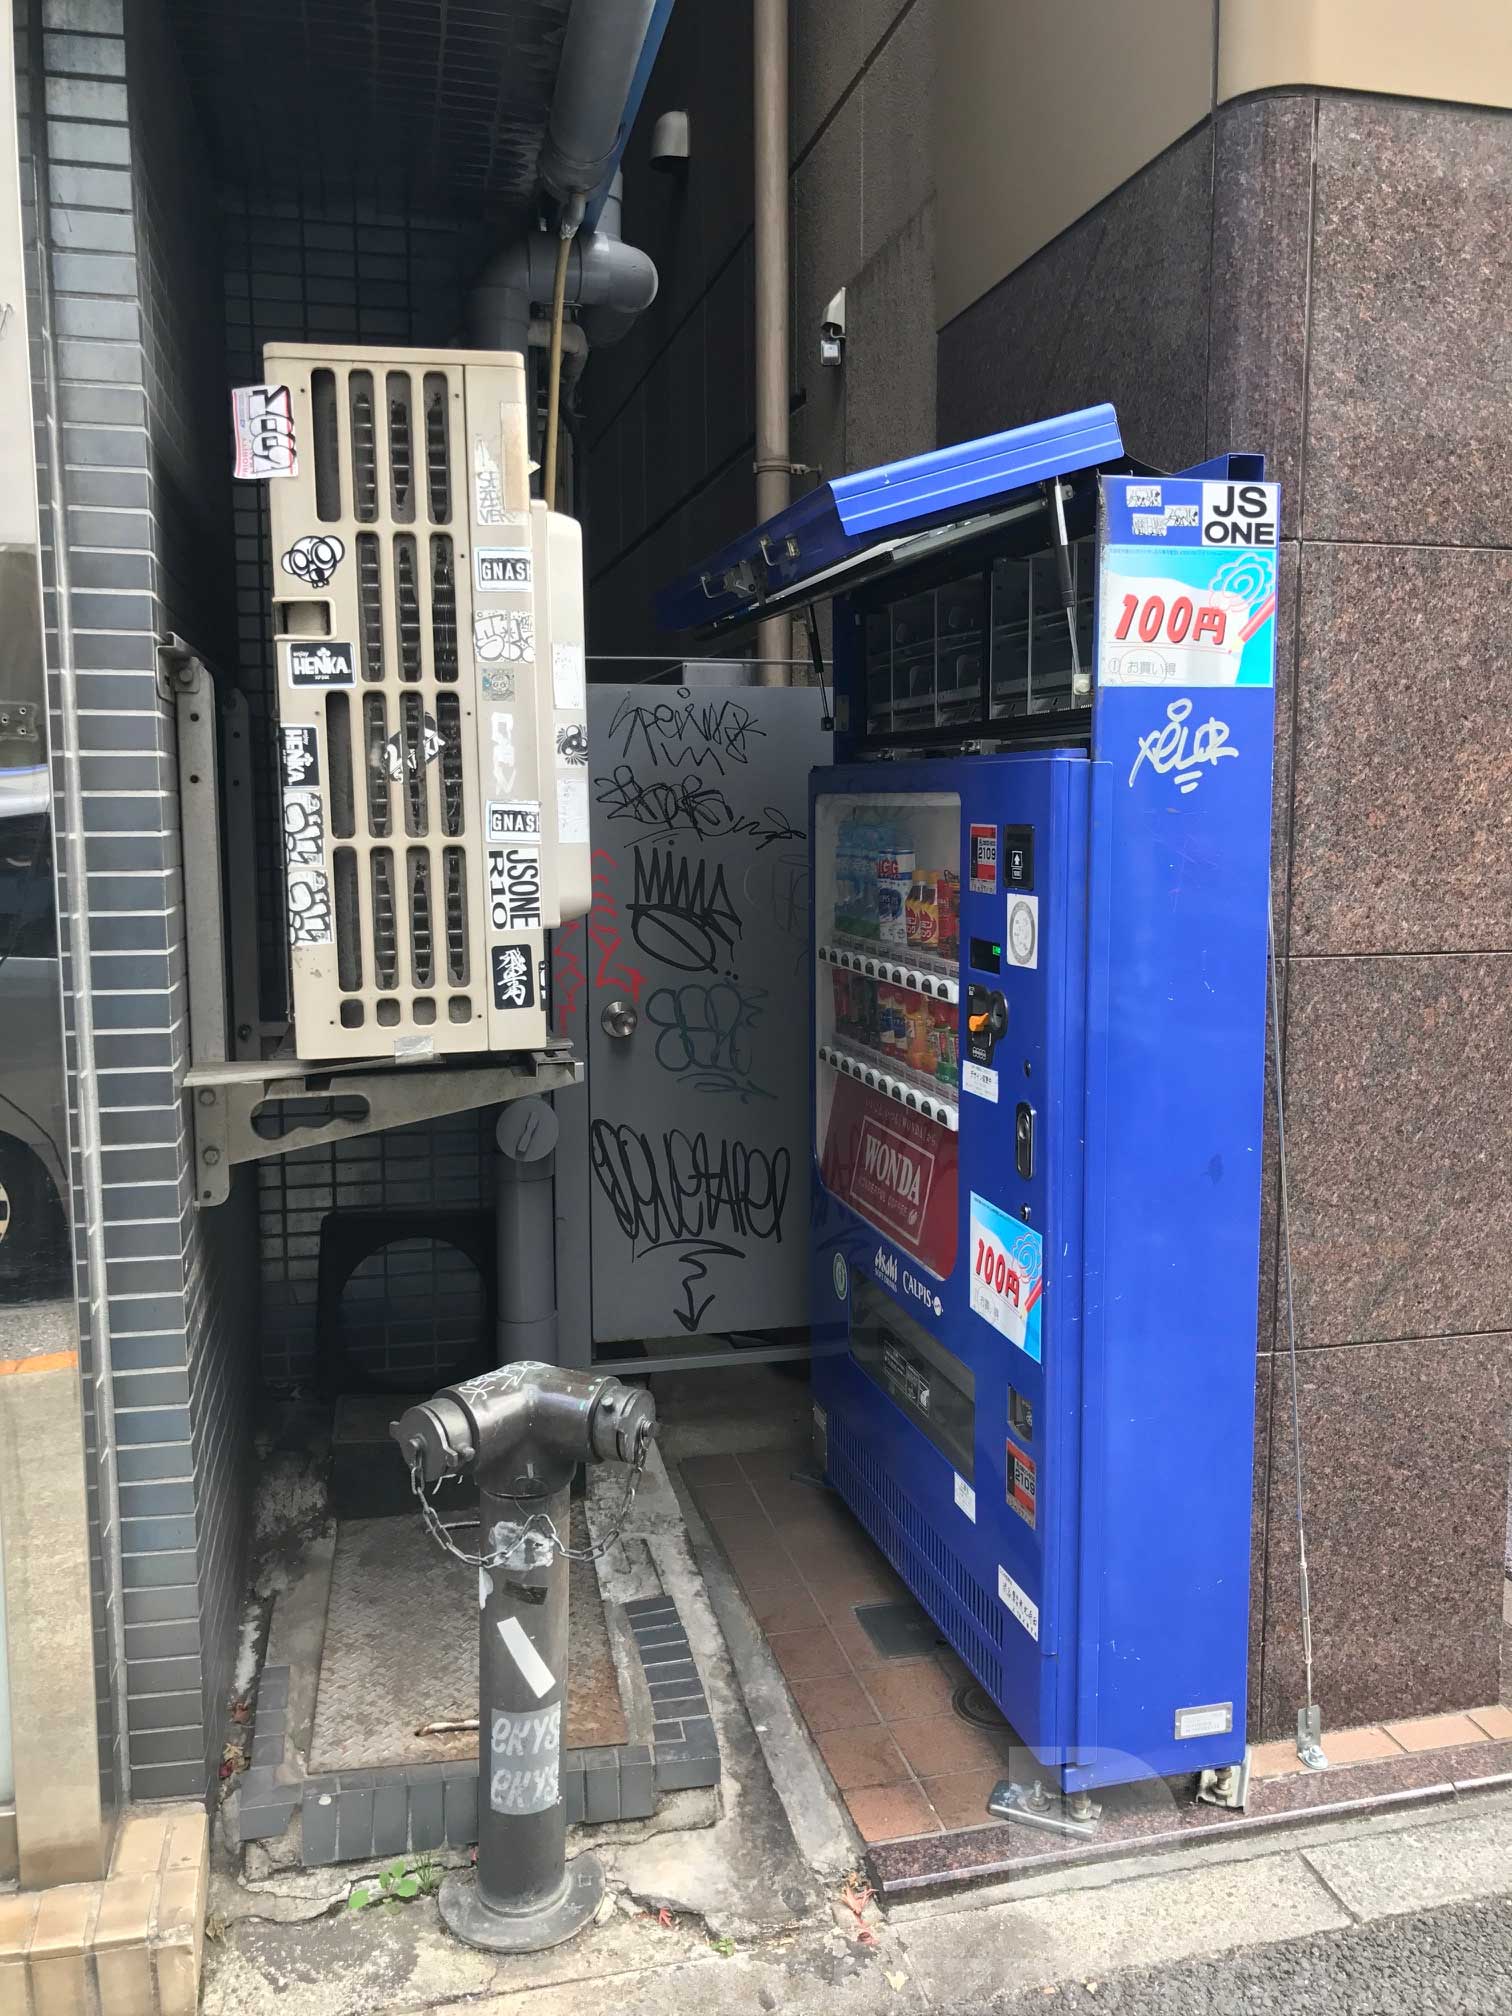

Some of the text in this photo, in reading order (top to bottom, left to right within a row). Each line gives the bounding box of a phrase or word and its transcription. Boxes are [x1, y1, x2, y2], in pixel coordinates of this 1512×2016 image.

[1212, 485, 1268, 519] JS
[1204, 520, 1275, 546] ONE
[1114, 593, 1227, 646] 100円
[293, 656, 348, 675] HENKA
[285, 729, 307, 784] HENKA
[978, 847, 996, 860] 2109
[506, 850, 541, 930] JSONE
[865, 1133, 921, 1206] WONDA
[874, 1246, 898, 1283] Asahi
[903, 1270, 932, 1308] CALPIS
[976, 1237, 1020, 1308] 100円
[1015, 1468, 1036, 1496] 2109
